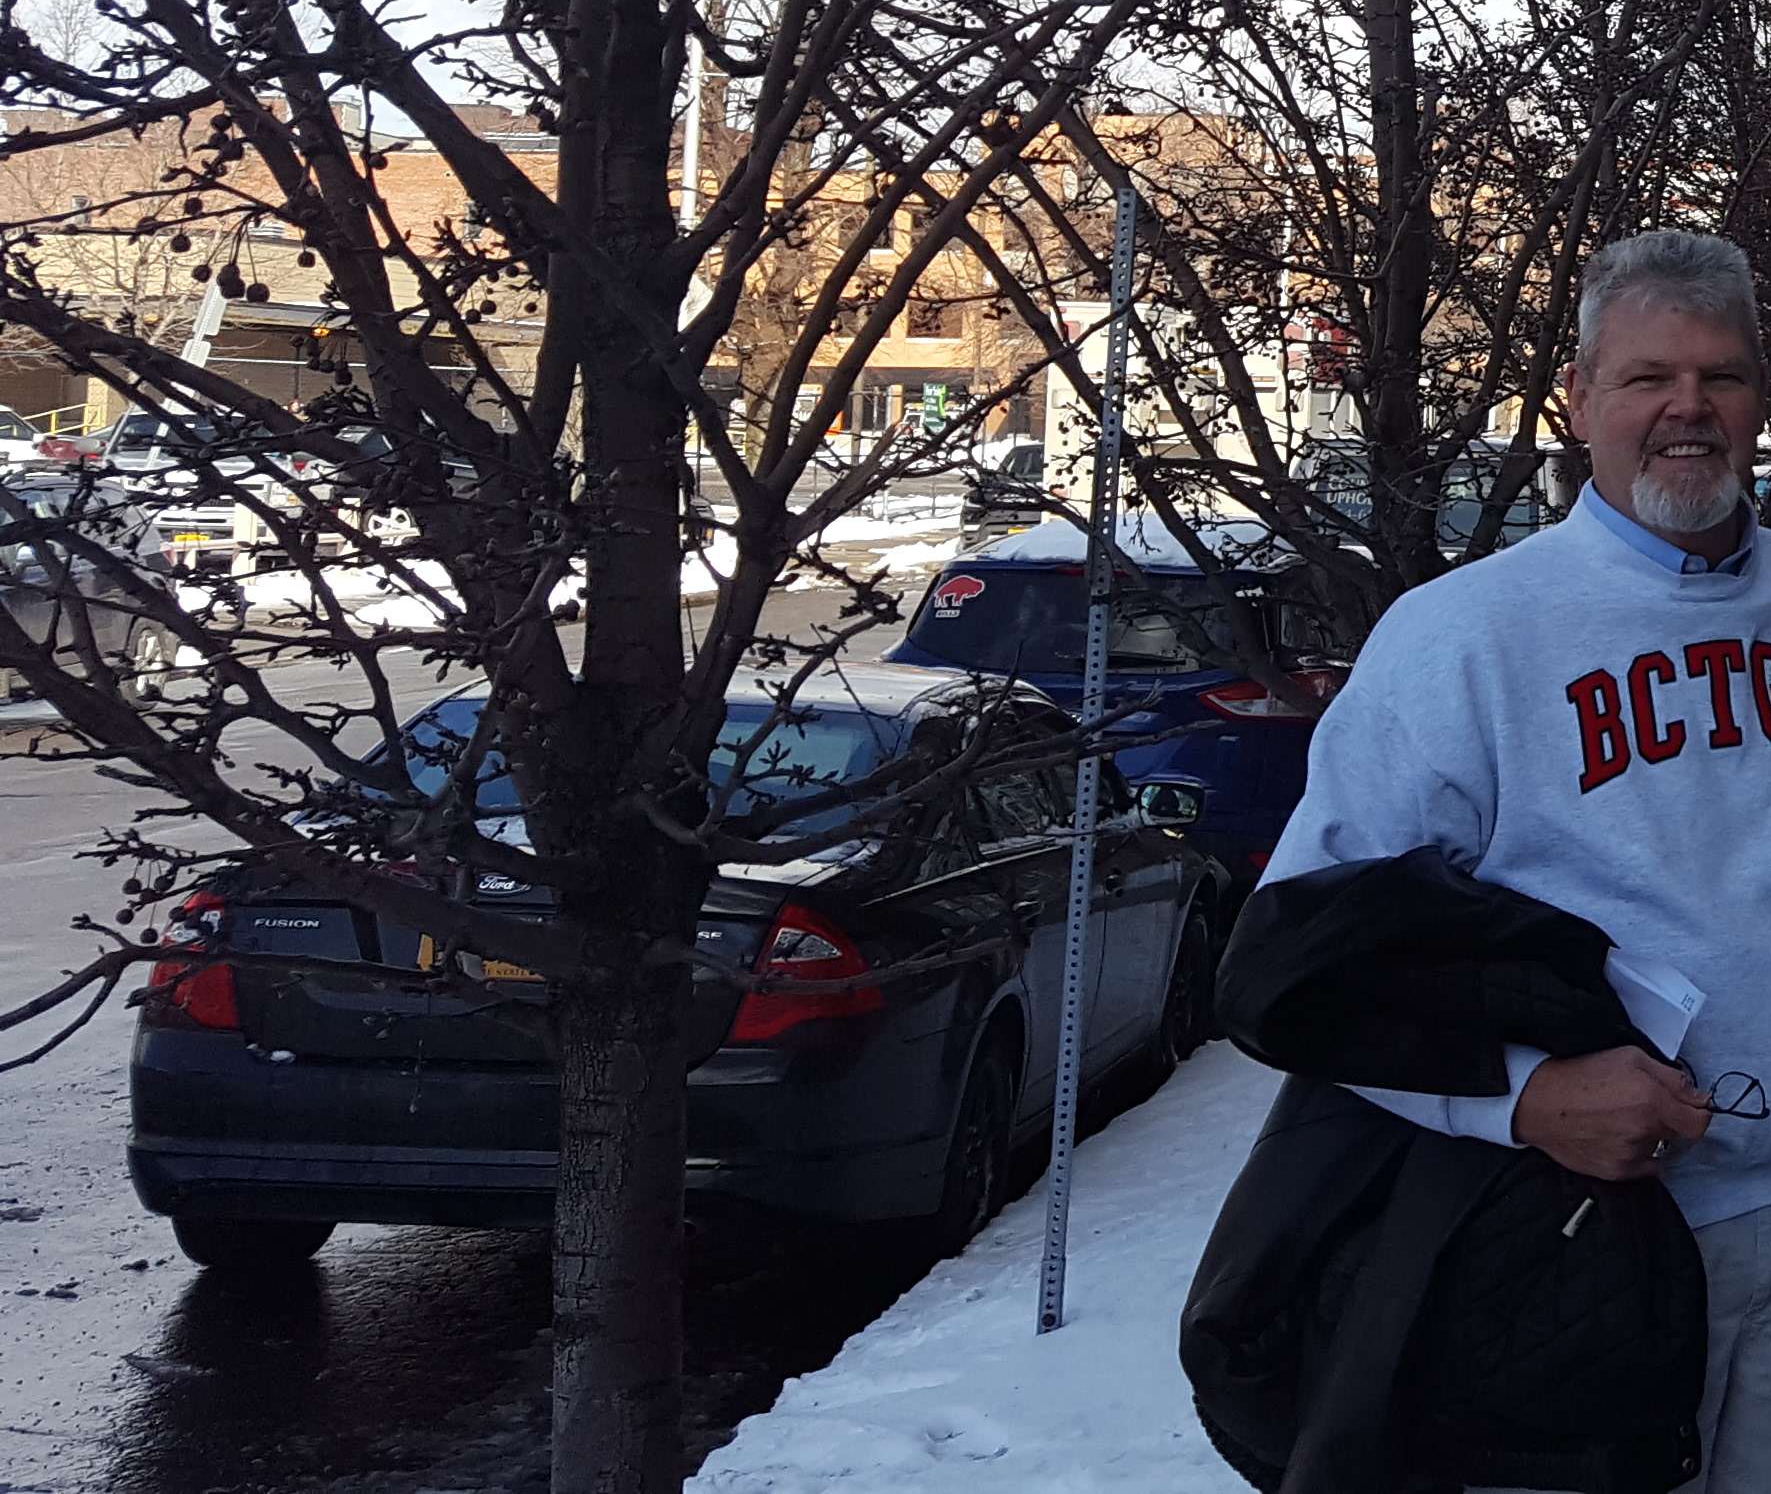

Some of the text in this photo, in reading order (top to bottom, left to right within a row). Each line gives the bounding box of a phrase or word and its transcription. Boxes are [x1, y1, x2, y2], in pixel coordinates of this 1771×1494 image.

[479, 875, 515, 891] Ford
[254, 918, 321, 929] FUSION
[697, 931, 724, 940] SE
